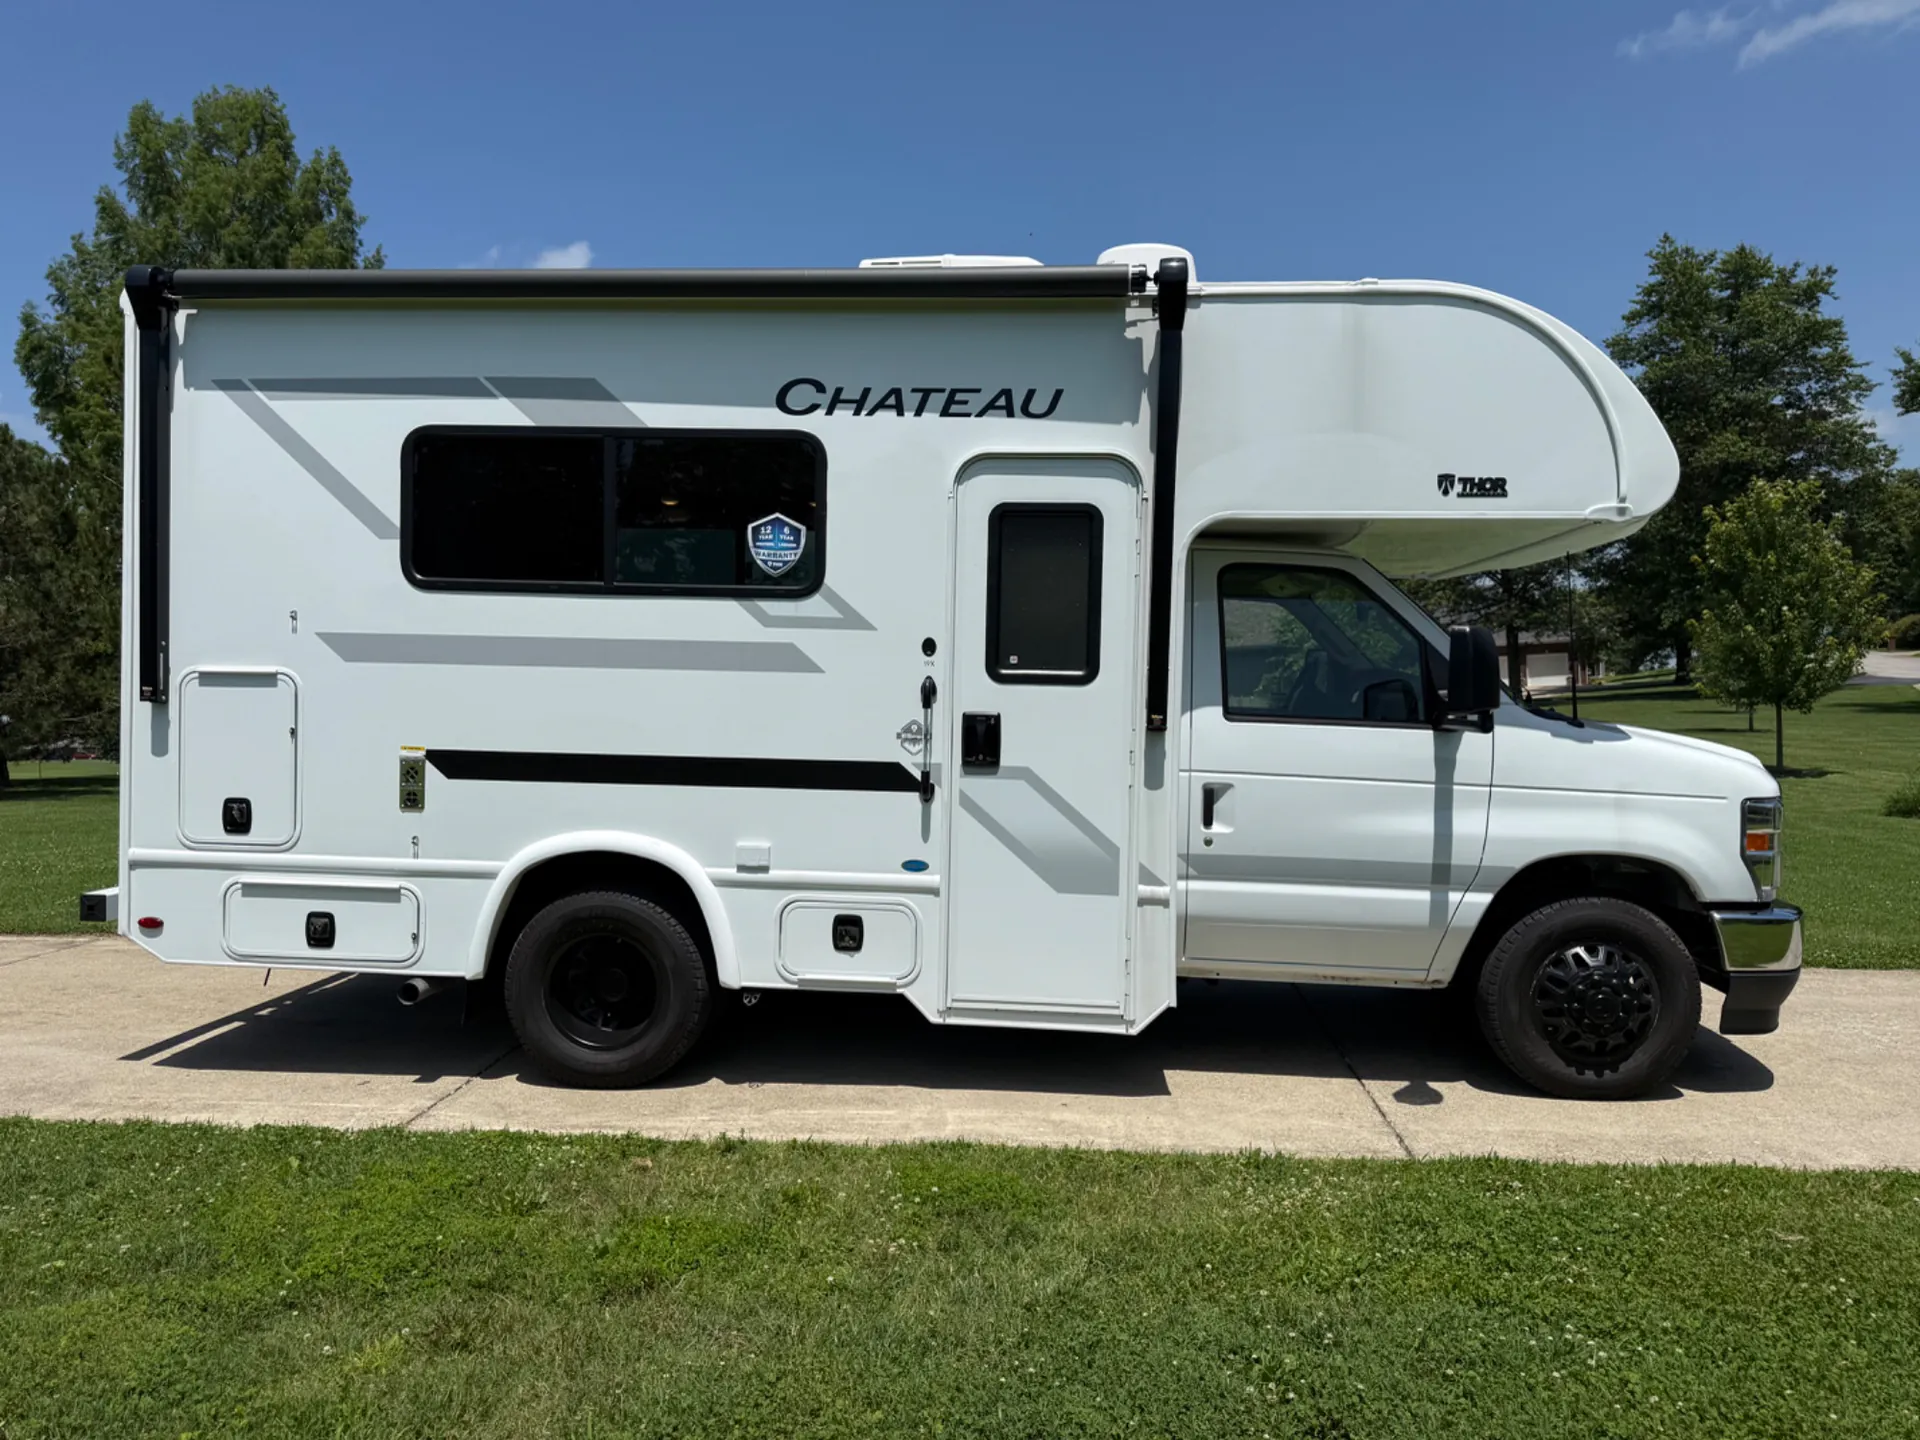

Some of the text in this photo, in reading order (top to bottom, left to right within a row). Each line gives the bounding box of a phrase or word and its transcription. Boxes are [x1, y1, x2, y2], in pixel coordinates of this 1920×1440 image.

[775, 377, 1064, 418] CHATEAU
[1458, 477, 1507, 493] THOR
[760, 525, 772, 534] 12
[754, 551, 798, 560] WARRANTY
